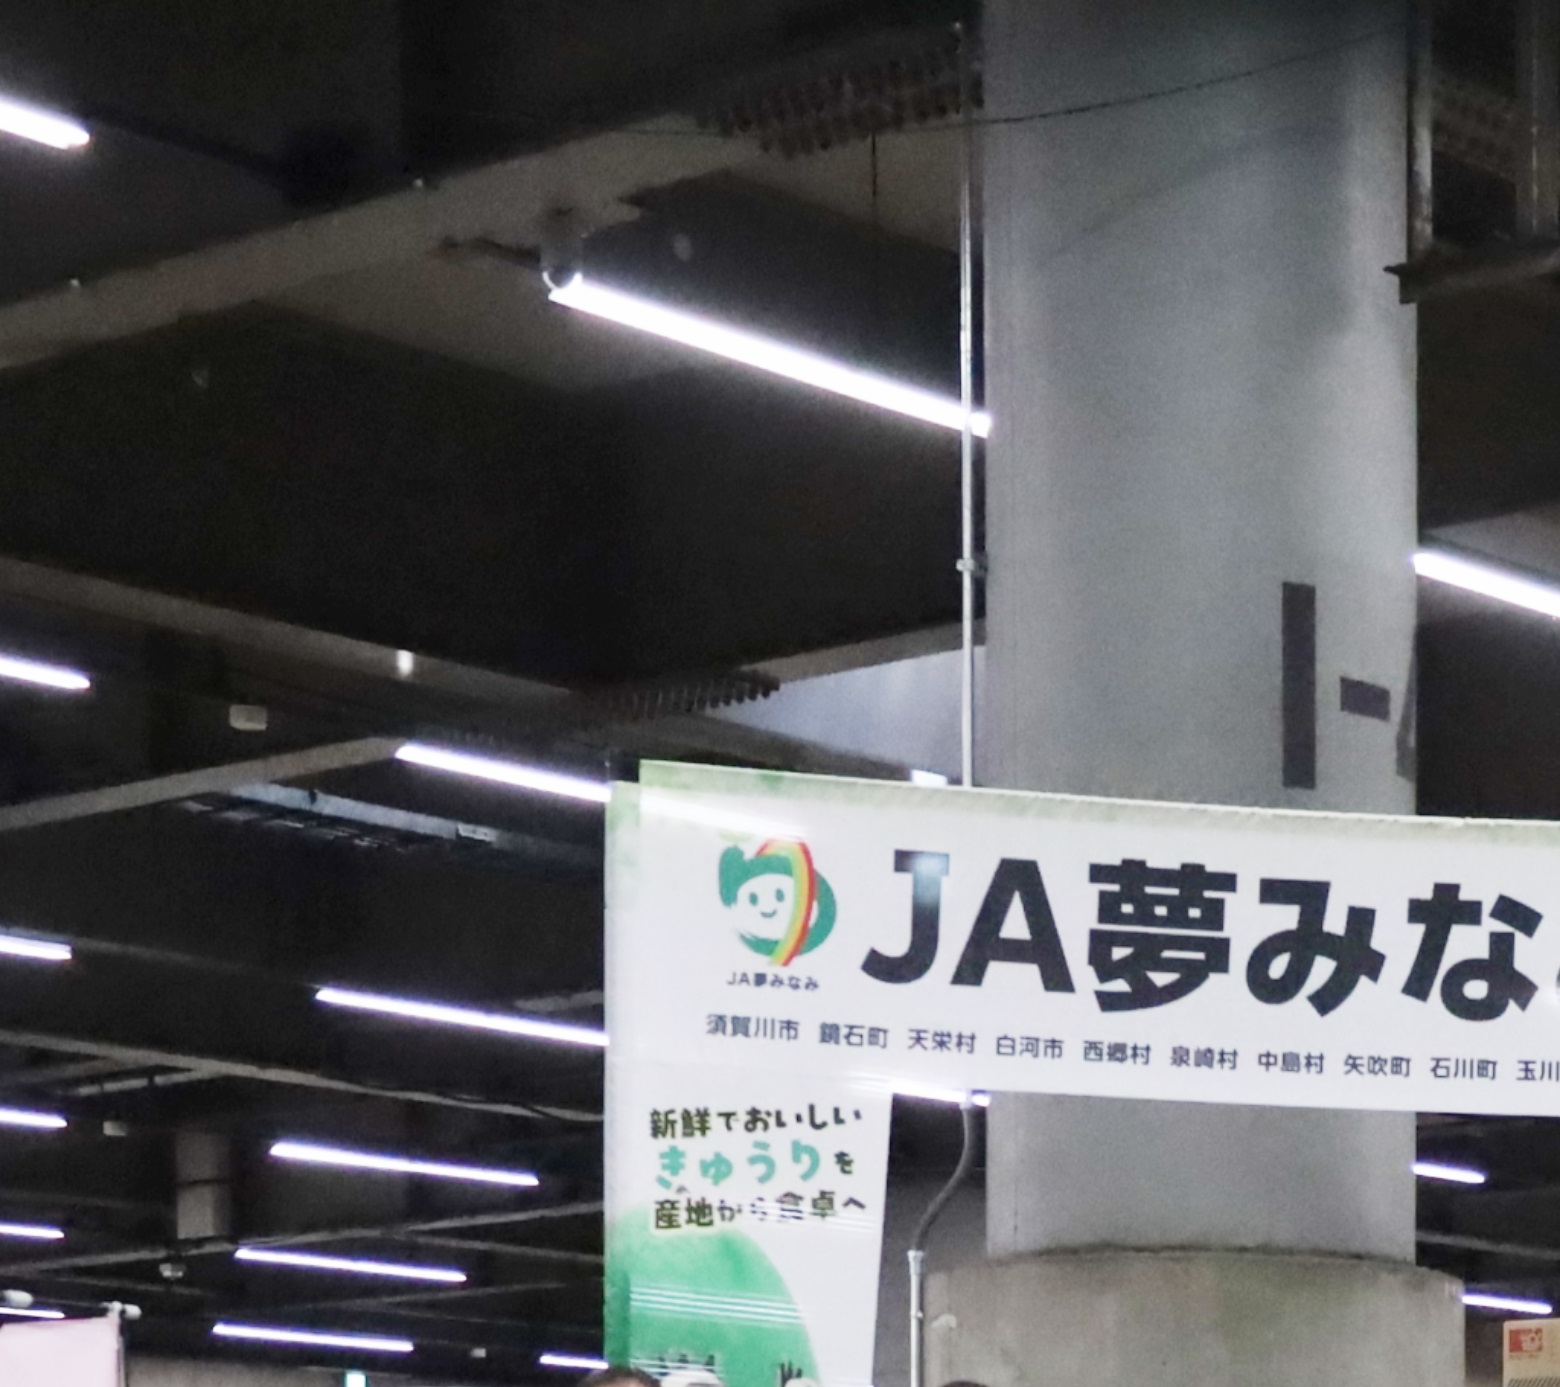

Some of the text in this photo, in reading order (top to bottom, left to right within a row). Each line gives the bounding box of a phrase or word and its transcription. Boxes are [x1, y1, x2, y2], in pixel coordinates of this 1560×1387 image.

[726, 971, 819, 991] JA夢みなみ
[705, 1013, 800, 1041] 須賀川市
[818, 1021, 889, 1050] 鏡石町
[906, 1029, 977, 1055] 天栄村
[995, 1034, 1065, 1060] 白河市
[1082, 1040, 1152, 1066] 西郷村
[1169, 1045, 1239, 1071] 泉崎村
[1256, 1051, 1325, 1075] 中島村
[1342, 1053, 1412, 1079] 矢吹町
[1428, 1056, 1499, 1082] 石川町
[649, 1103, 862, 1139] 新鮮でおいしい
[656, 1140, 854, 1189] きゅうりを
